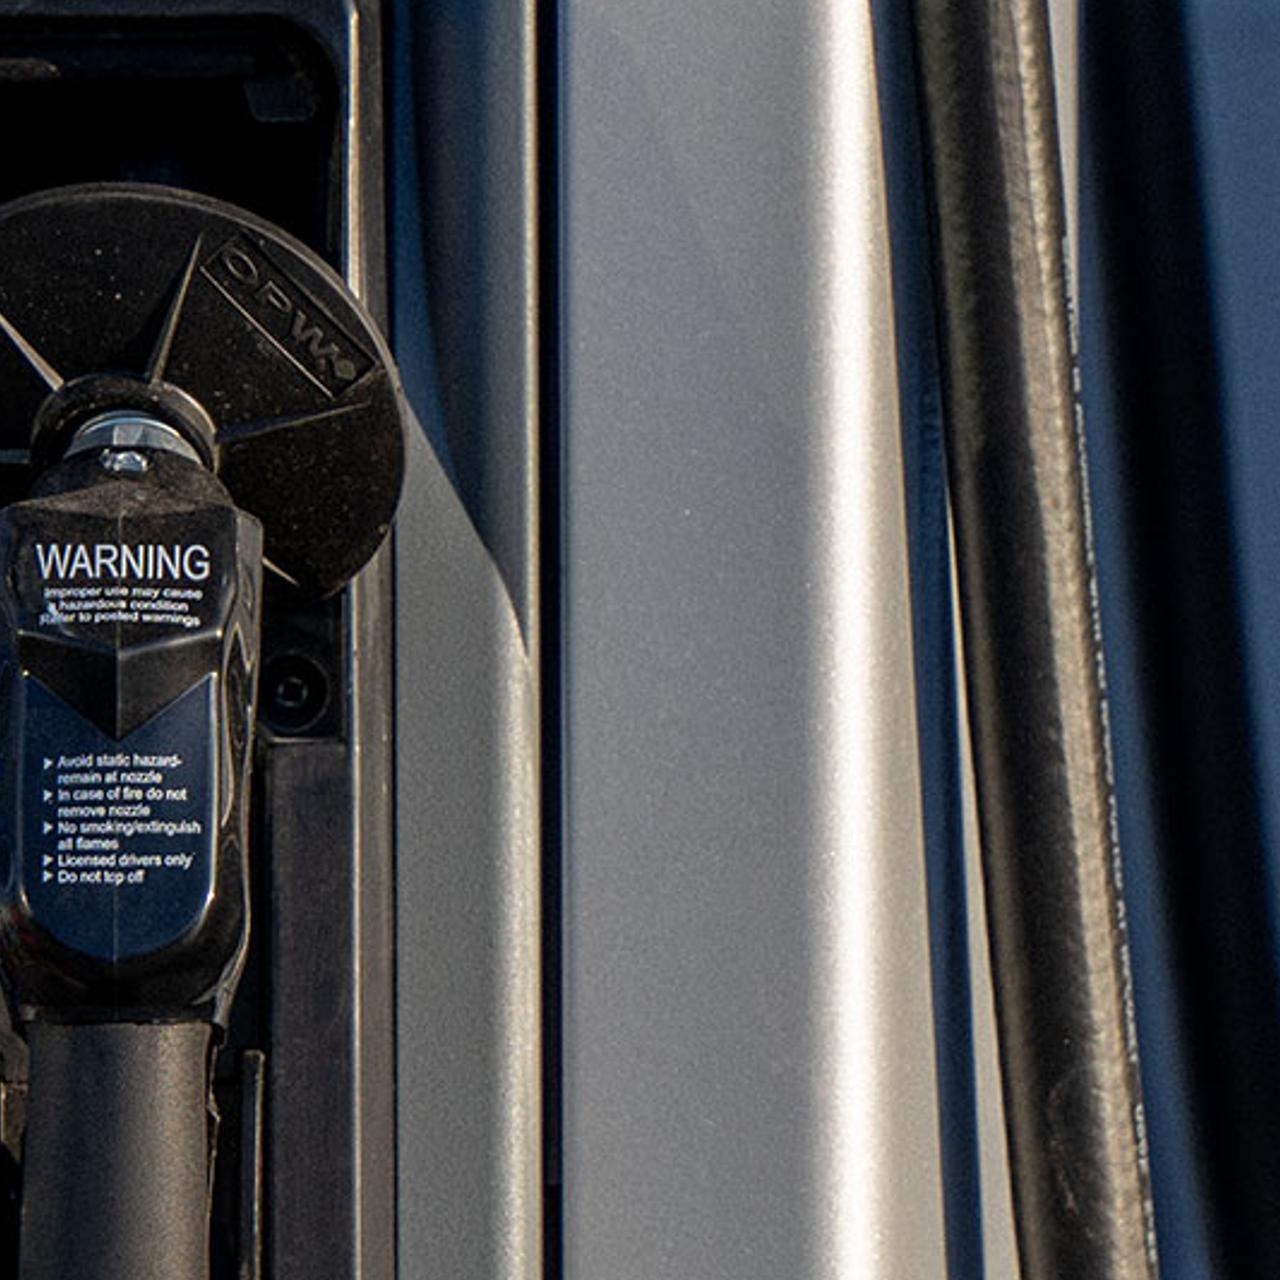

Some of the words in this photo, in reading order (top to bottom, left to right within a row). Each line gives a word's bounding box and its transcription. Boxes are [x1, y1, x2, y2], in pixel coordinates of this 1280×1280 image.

[36, 544, 210, 580] WARNING
[44, 587, 101, 599] Improper
[105, 588, 129, 596] use
[132, 588, 160, 600] may
[164, 588, 203, 599] cause
[59, 600, 126, 610] hazardous
[130, 600, 189, 611] condition
[78, 612, 92, 623] to
[94, 611, 139, 624] posted
[142, 613, 200, 627] warnings
[58, 755, 93, 768] Avoid
[96, 754, 130, 767] static
[58, 773, 101, 783] remain
[104, 772, 118, 782] at
[120, 771, 162, 783] nozzle
[58, 789, 70, 800] In
[73, 790, 103, 800] case
[106, 788, 120, 799] of
[123, 788, 143, 799] fire
[145, 788, 163, 799] do
[166, 788, 187, 799] not
[58, 806, 106, 817] remove
[109, 804, 150, 816] nozzle
[58, 822, 77, 833] No
[80, 821, 201, 836] smoking/extinguish
[58, 839, 72, 850] all
[77, 838, 119, 850] flames
[58, 855, 116, 867] Licensed
[119, 854, 162, 866] drivers
[165, 854, 193, 869] only
[58, 871, 77, 882] Do
[80, 871, 102, 882] not
[104, 871, 125, 885] top
[127, 870, 145, 882] off
